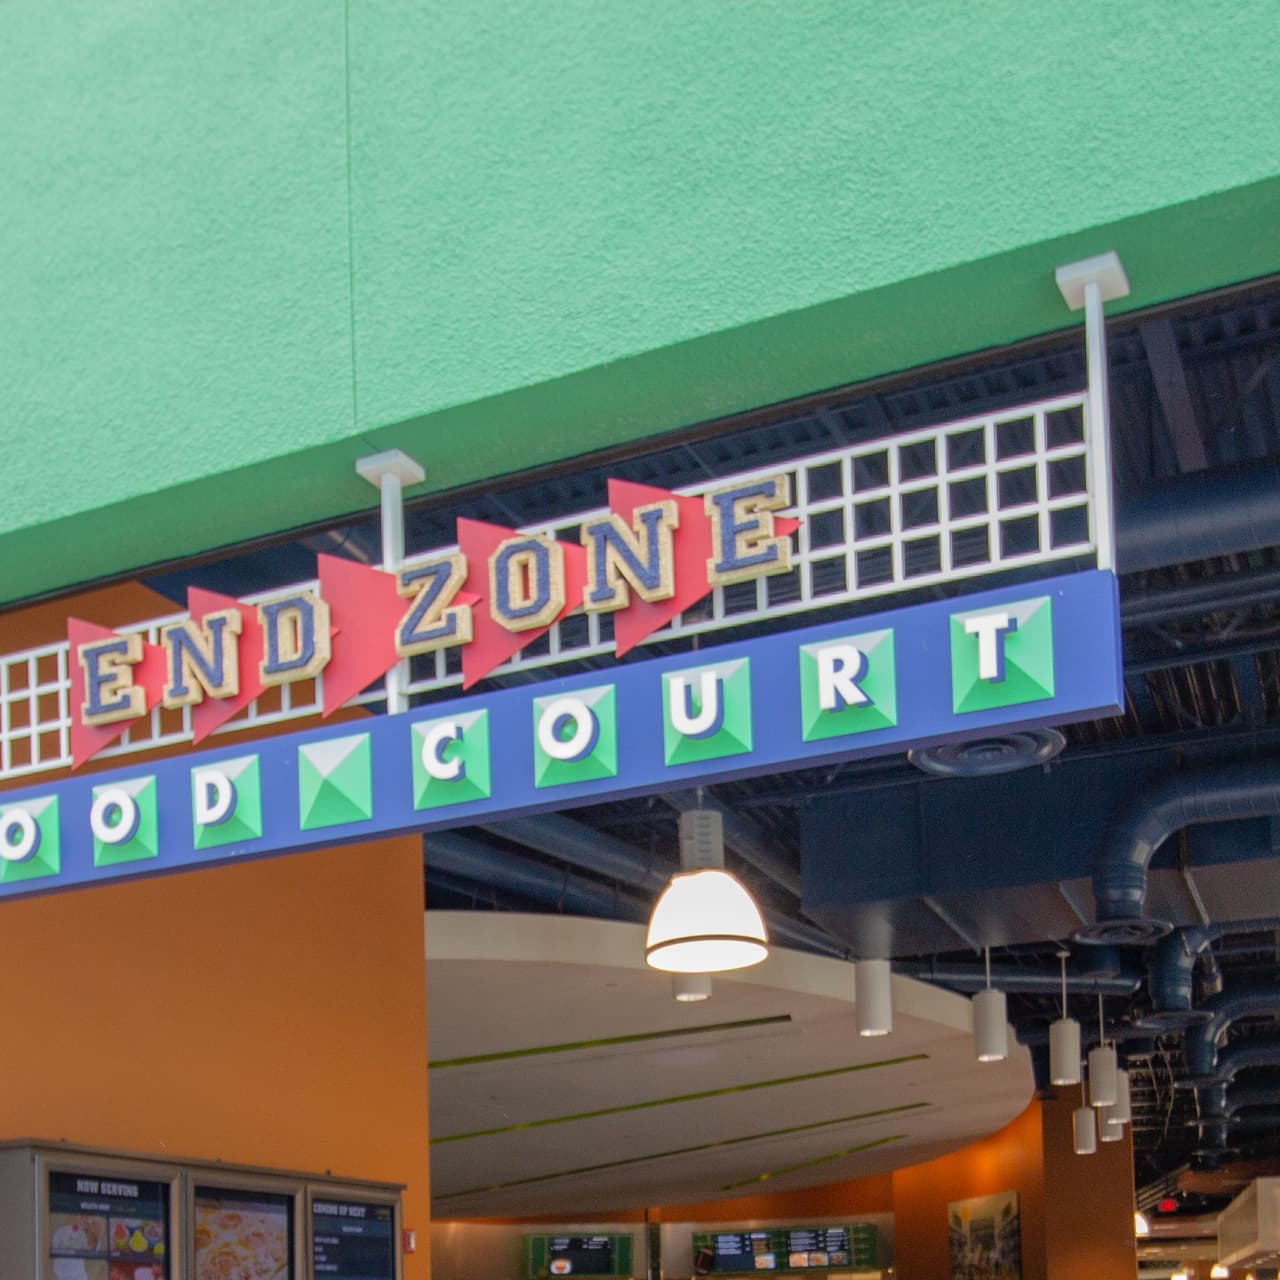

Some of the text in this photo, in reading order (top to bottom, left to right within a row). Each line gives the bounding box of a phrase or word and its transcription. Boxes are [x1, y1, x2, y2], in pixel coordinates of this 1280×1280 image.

[78, 474, 794, 726] END ZONE
[421, 612, 1017, 780] COURT
[76, 1179, 139, 1198] NOW SERVING
